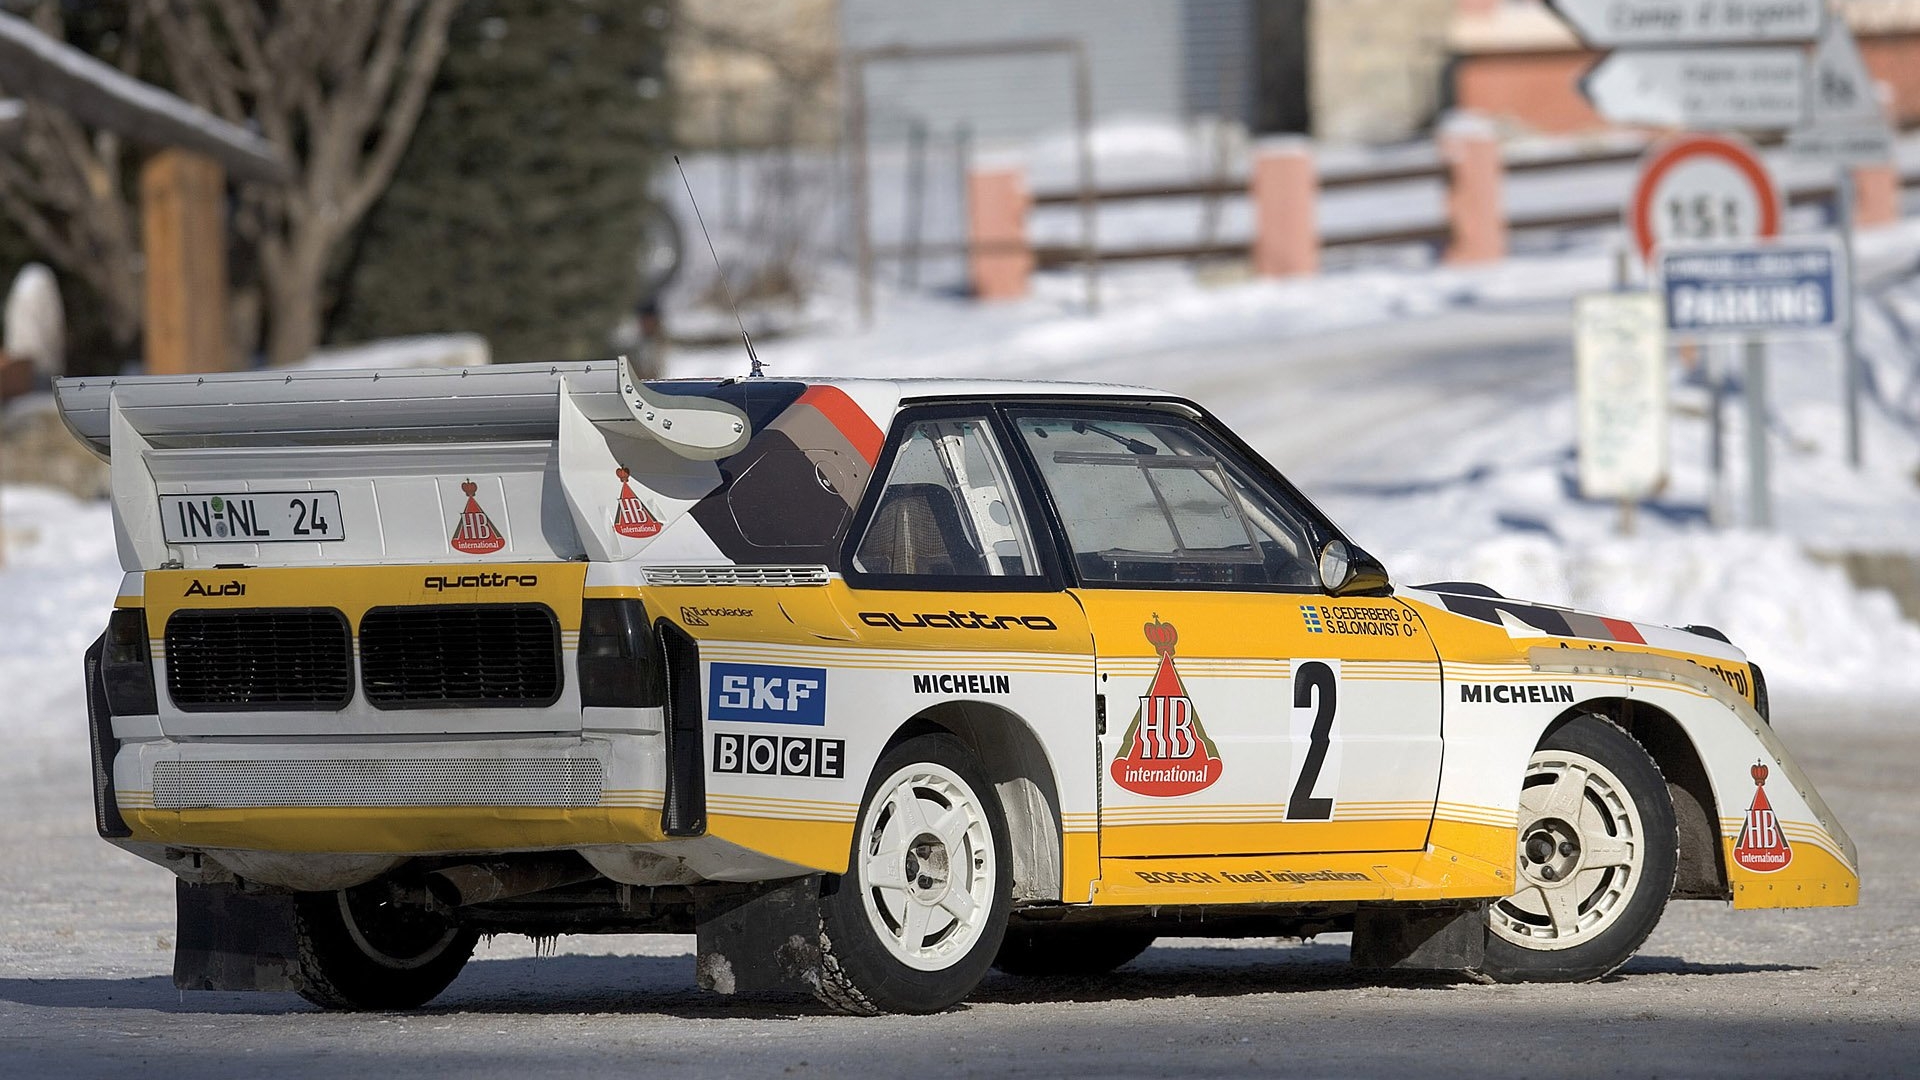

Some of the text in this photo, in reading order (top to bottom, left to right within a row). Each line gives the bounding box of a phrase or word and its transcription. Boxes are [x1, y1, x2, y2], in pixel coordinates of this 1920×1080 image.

[1672, 283, 1827, 325] PARKING
[289, 498, 328, 535] 24
[618, 498, 648, 523] HB
[460, 512, 491, 540] HB
[621, 524, 657, 534] international
[458, 541, 499, 550] international
[183, 579, 246, 597] Audi
[424, 572, 538, 592] quattro
[689, 606, 754, 617] Turbolader
[858, 610, 1058, 632] quattro
[1320, 606, 1401, 621] B.CEDERBERG
[1326, 620, 1400, 636] S.BLOMQVIST
[719, 674, 819, 712] SKF
[913, 675, 1010, 694] MICHELIN
[1460, 685, 1575, 703] MICHELIN
[1137, 695, 1197, 760] HB
[1285, 660, 1338, 821] 2
[719, 738, 839, 776] BOGE
[1124, 764, 1209, 784] international
[1745, 808, 1778, 850] HB
[1741, 851, 1786, 864] international
[1134, 869, 1373, 884] BOSCH fuel injection
